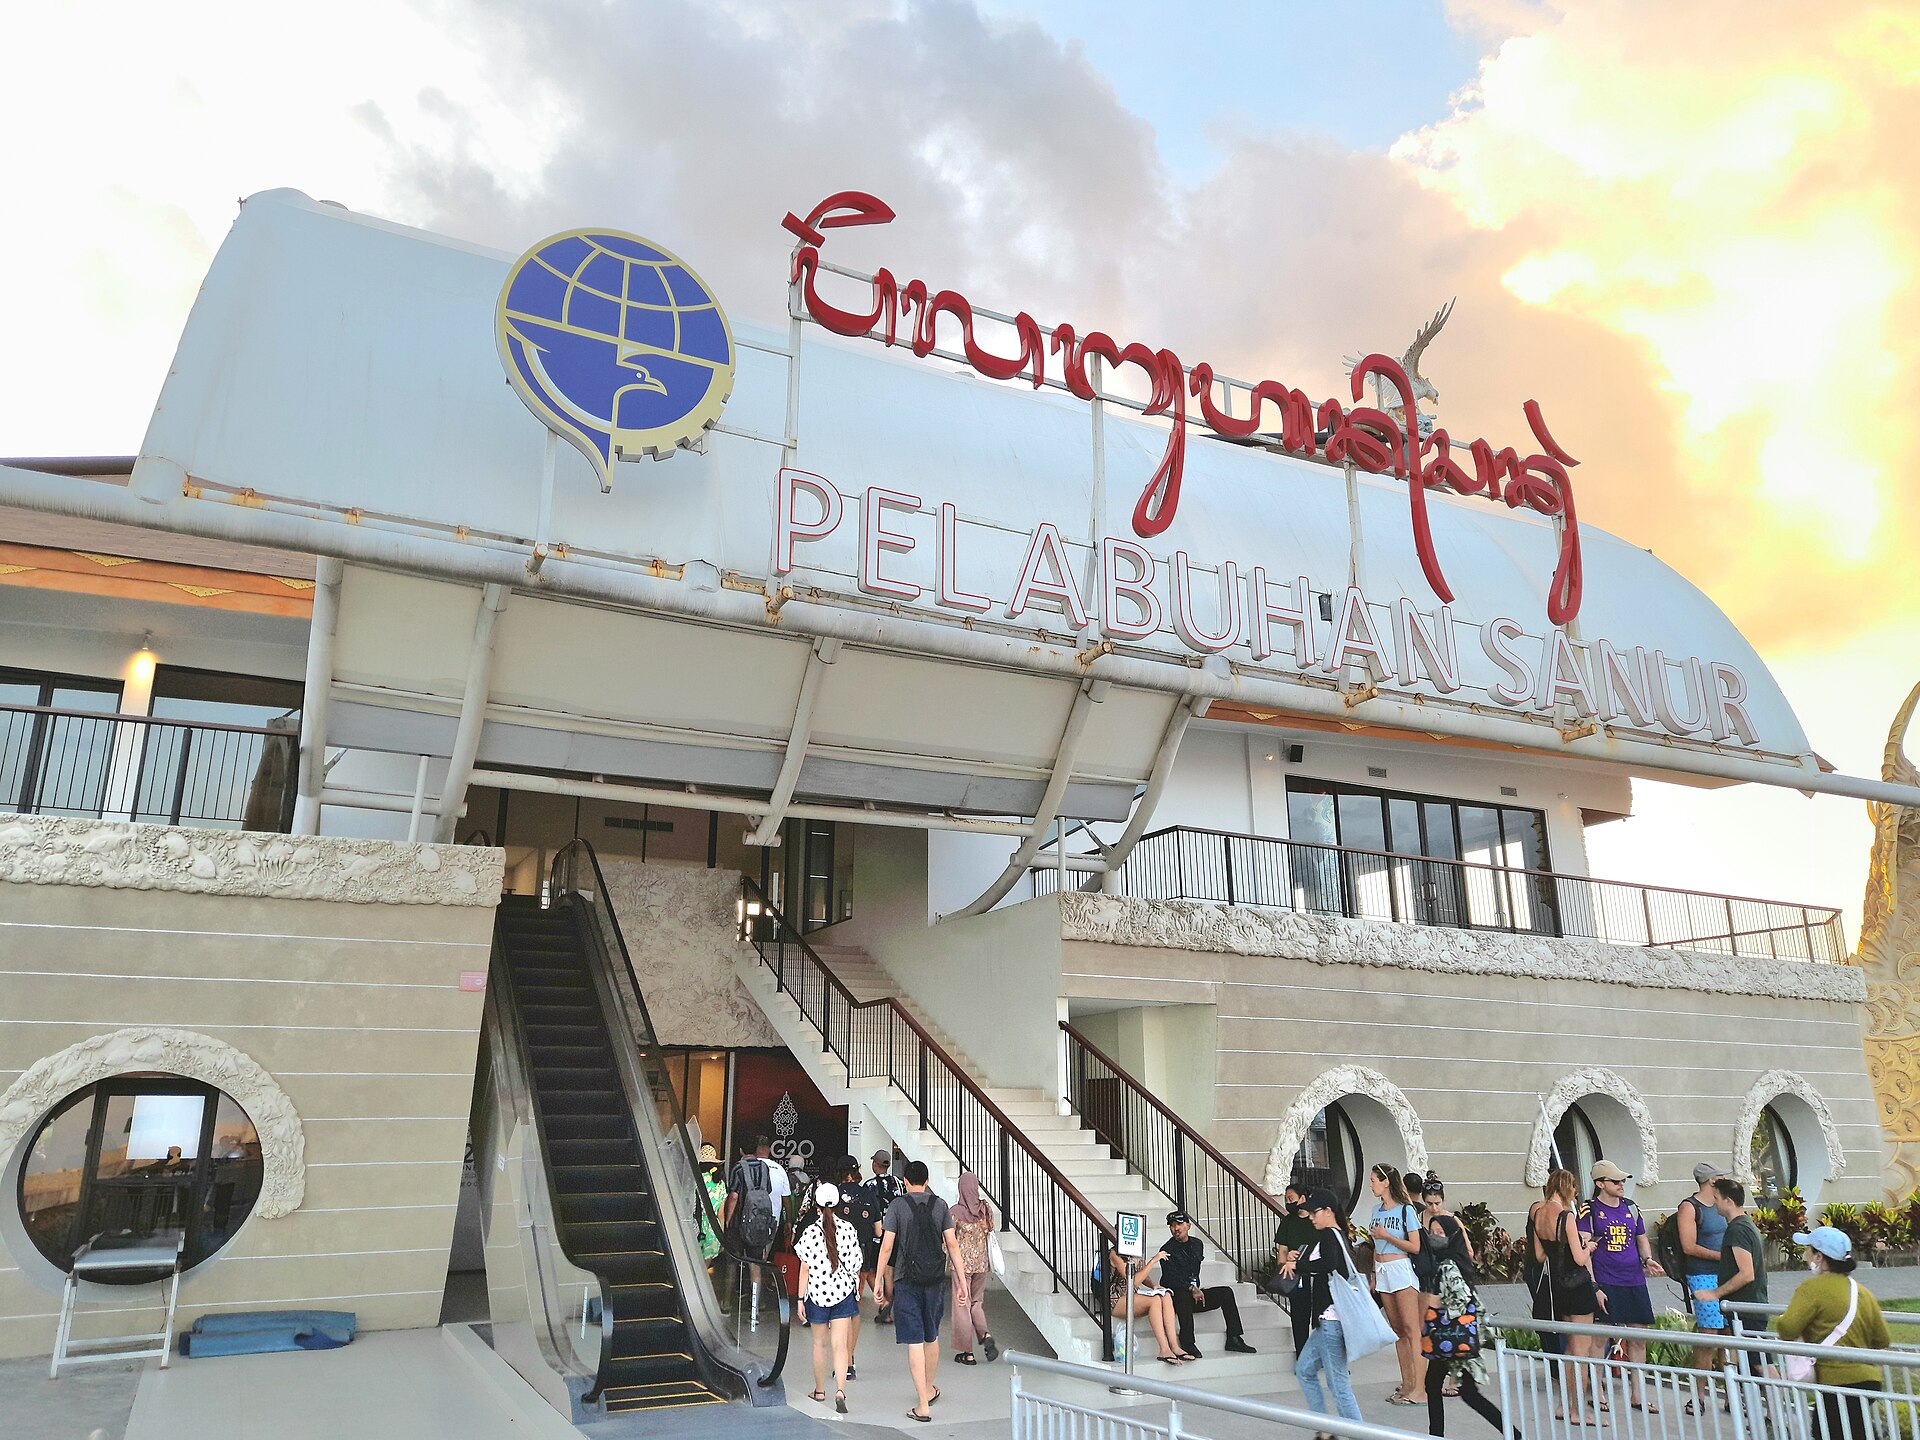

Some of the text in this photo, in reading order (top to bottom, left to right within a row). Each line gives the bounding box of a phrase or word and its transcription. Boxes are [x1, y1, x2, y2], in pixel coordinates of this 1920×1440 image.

[772, 467, 1760, 746] PELABUHAN SANUR
[770, 1139, 815, 1159] G20
[1383, 1216, 1400, 1231] YORK
[1609, 1225, 1627, 1236] DEE
[1610, 1235, 1627, 1245] JAY
